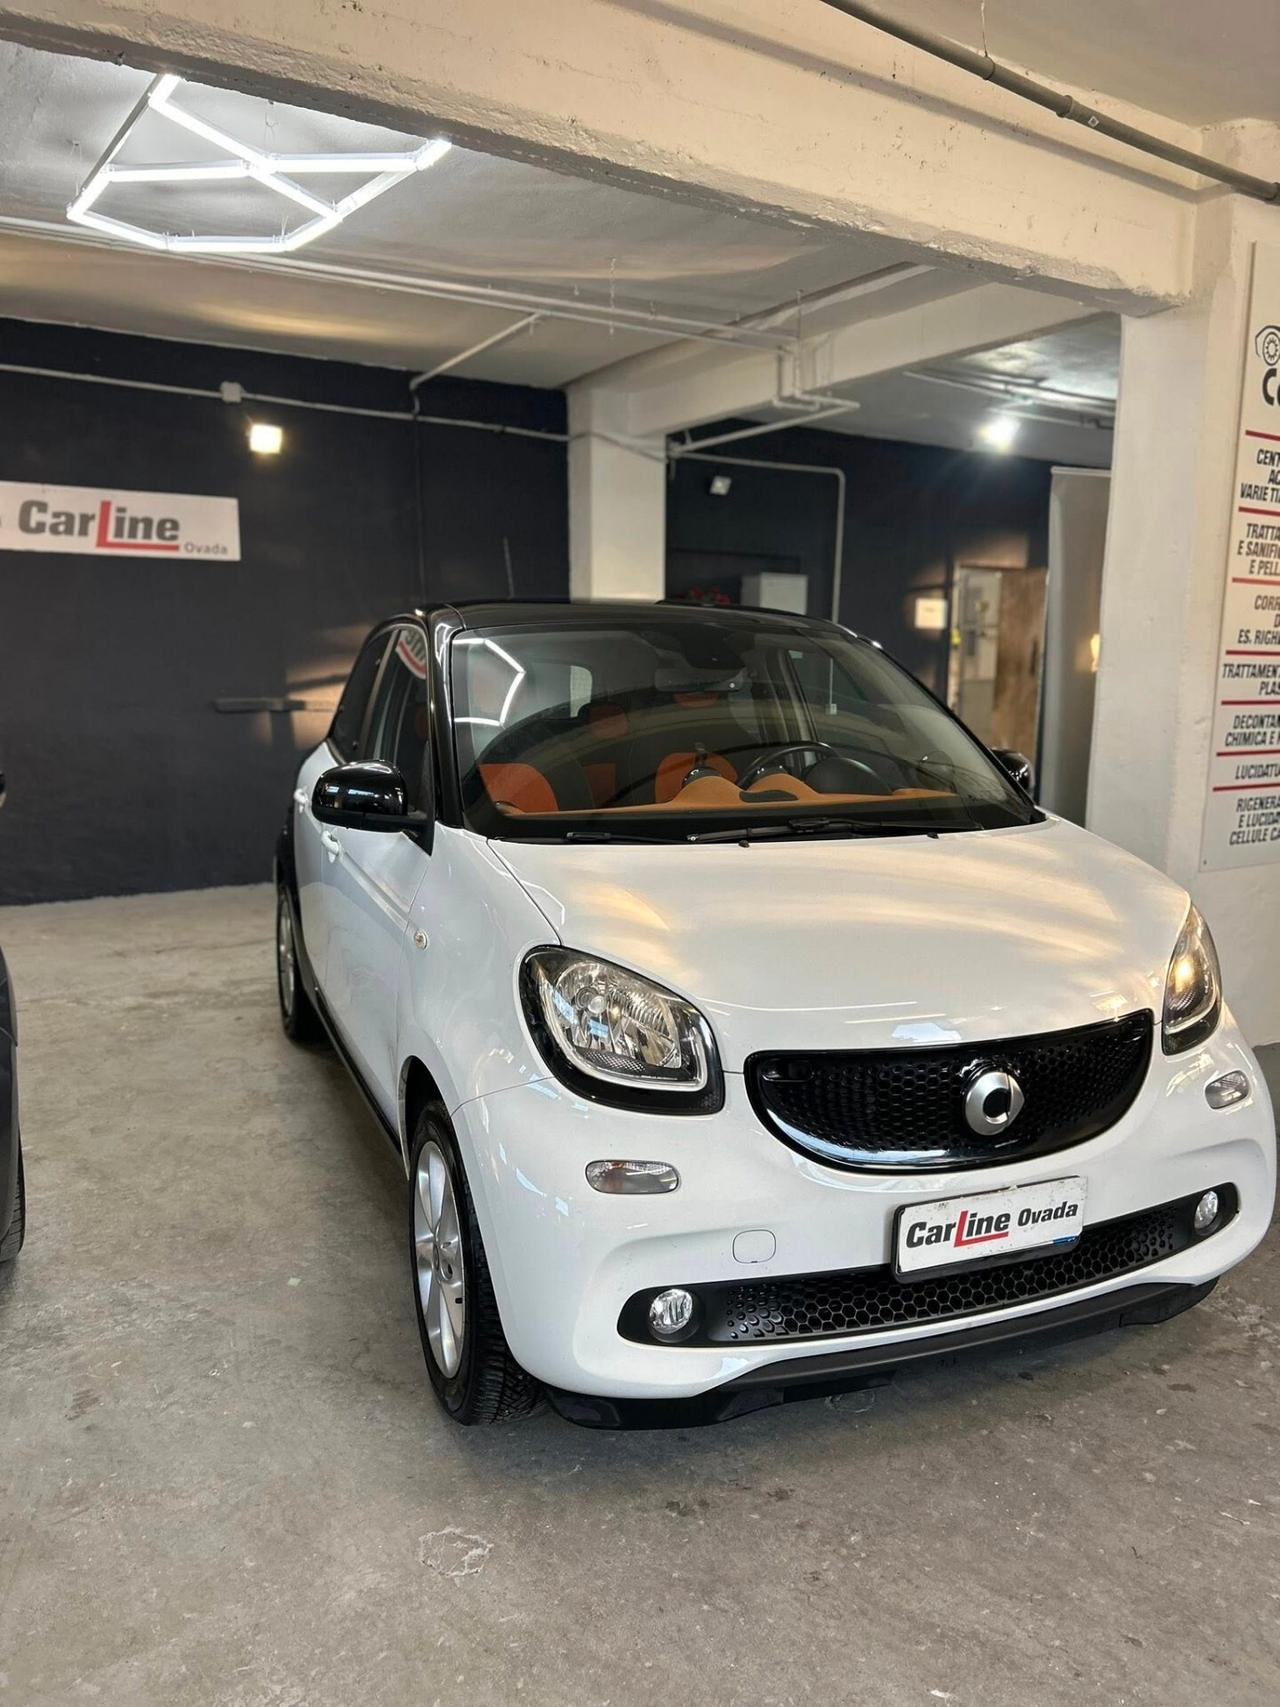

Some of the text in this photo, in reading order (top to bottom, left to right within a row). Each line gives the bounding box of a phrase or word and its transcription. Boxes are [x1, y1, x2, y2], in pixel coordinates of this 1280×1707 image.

[1262, 367, 1280, 406] C
[1240, 482, 1280, 503] VARIE TI
[184, 542, 228, 555] Ovada
[1237, 540, 1245, 555] E
[1249, 560, 1257, 575] E
[1254, 630, 1280, 645] RIGH
[1225, 731, 1267, 747] CHIMICA
[1269, 731, 1275, 745] E
[1238, 814, 1245, 828] E
[1229, 828, 1268, 846] CELLULE
[1017, 1201, 1079, 1227] Ovada
